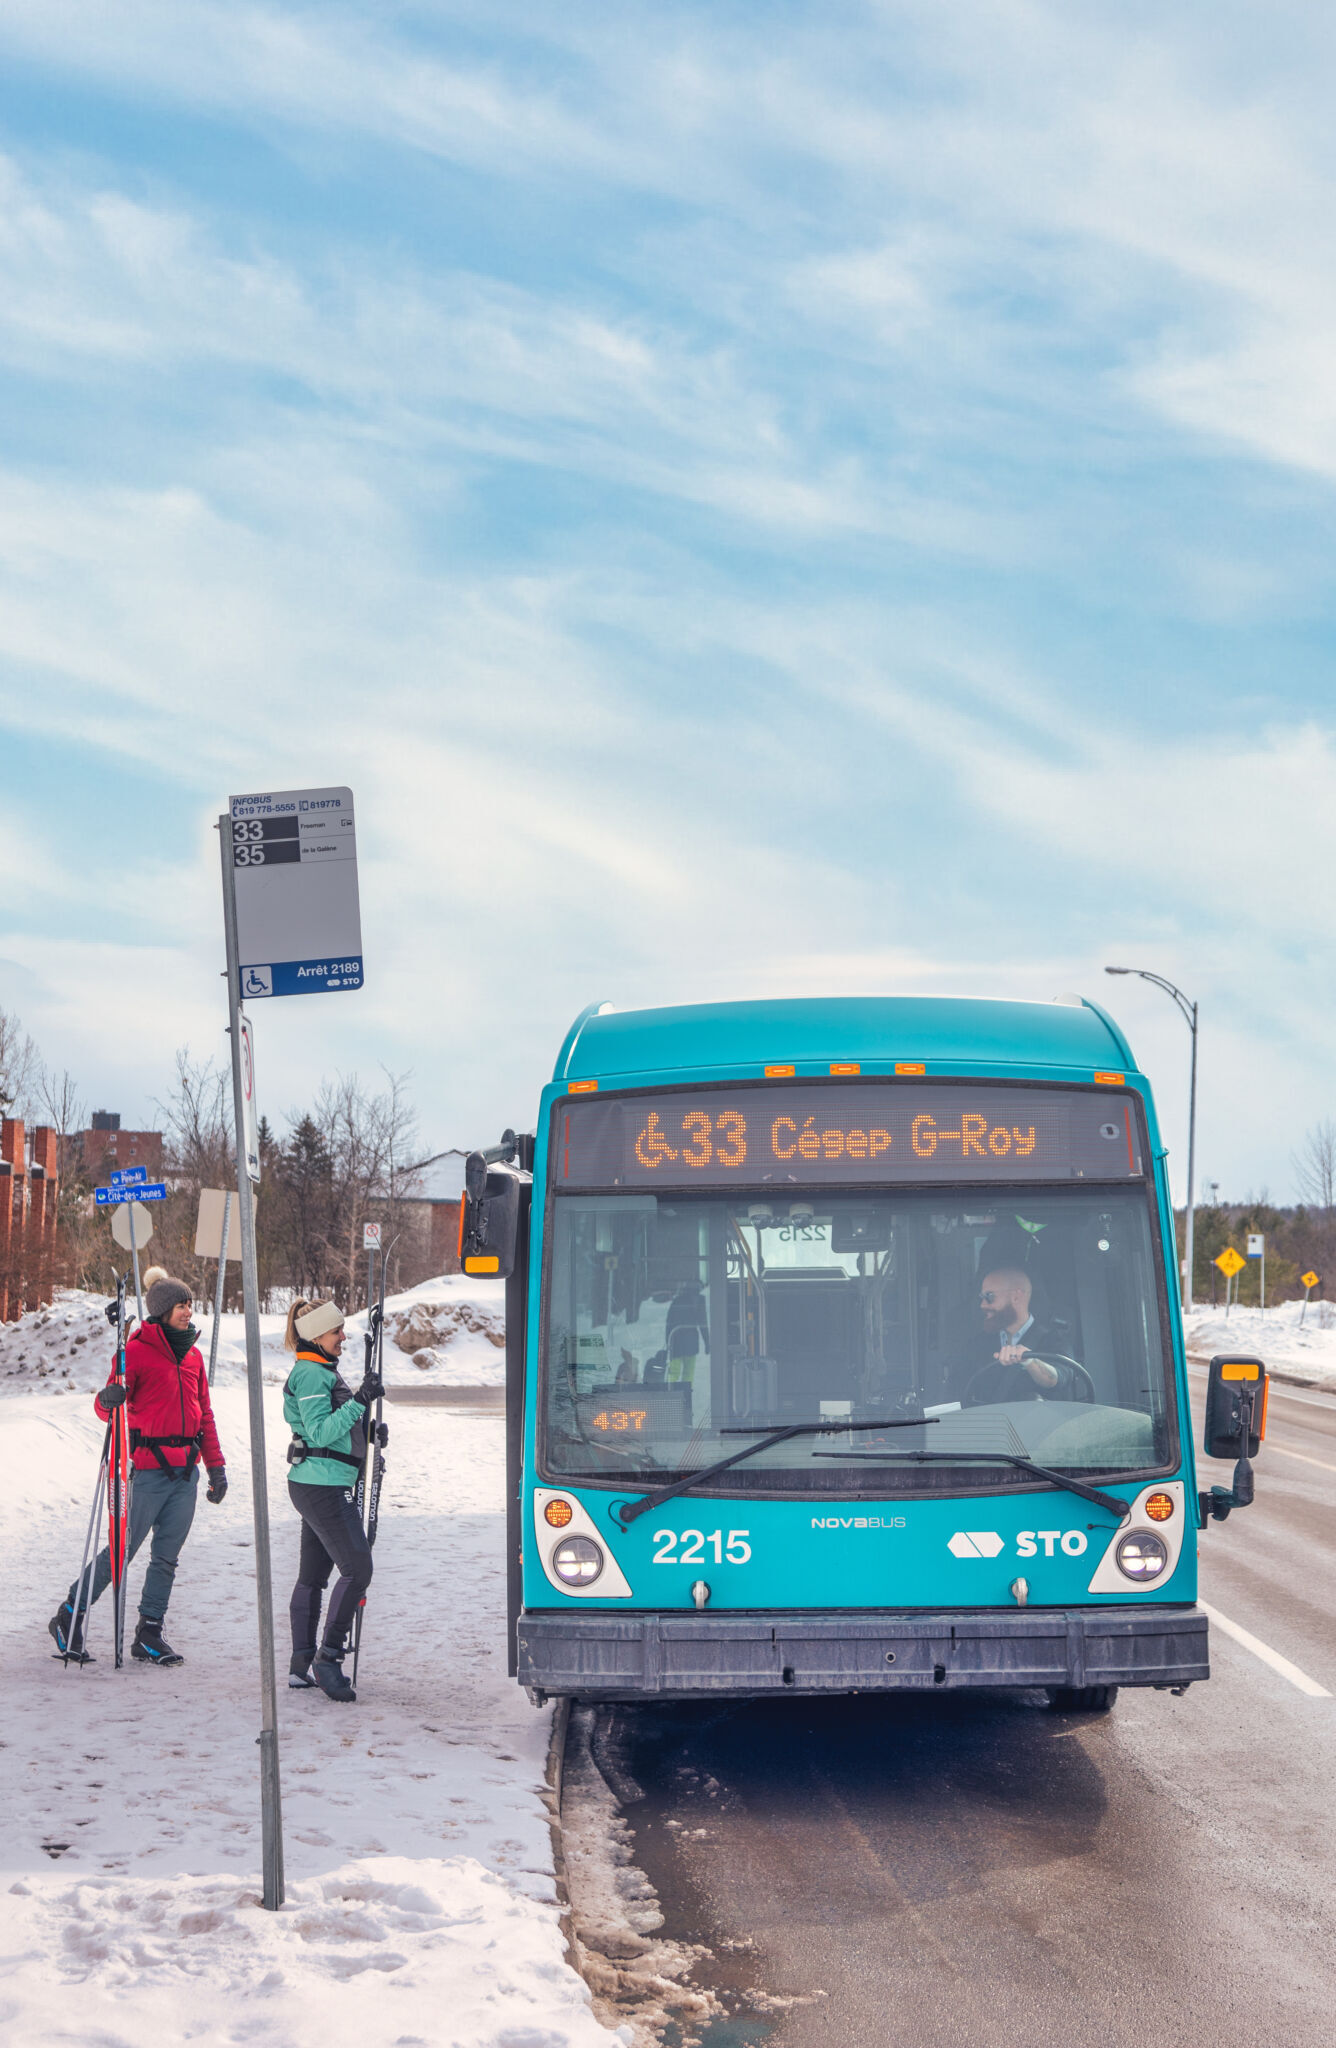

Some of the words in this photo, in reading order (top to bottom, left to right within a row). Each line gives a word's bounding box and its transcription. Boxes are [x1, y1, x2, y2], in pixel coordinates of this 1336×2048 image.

[232, 795, 272, 806] INFOBUS
[238, 806, 255, 815] 819
[256, 803, 296, 813] 778-5555
[310, 799, 341, 809] 819778
[234, 820, 264, 842] 33
[235, 844, 266, 866] 35
[297, 964, 328, 977] Arrêt
[331, 961, 360, 975] 2189
[342, 977, 360, 985] STO
[682, 1111, 747, 1167] 33
[771, 1116, 892, 1158] Cégep
[911, 1113, 1036, 1157] G-Roy
[592, 1410, 647, 1430] 437
[652, 1529, 752, 1564] 2215
[1016, 1530, 1088, 1558] STO
